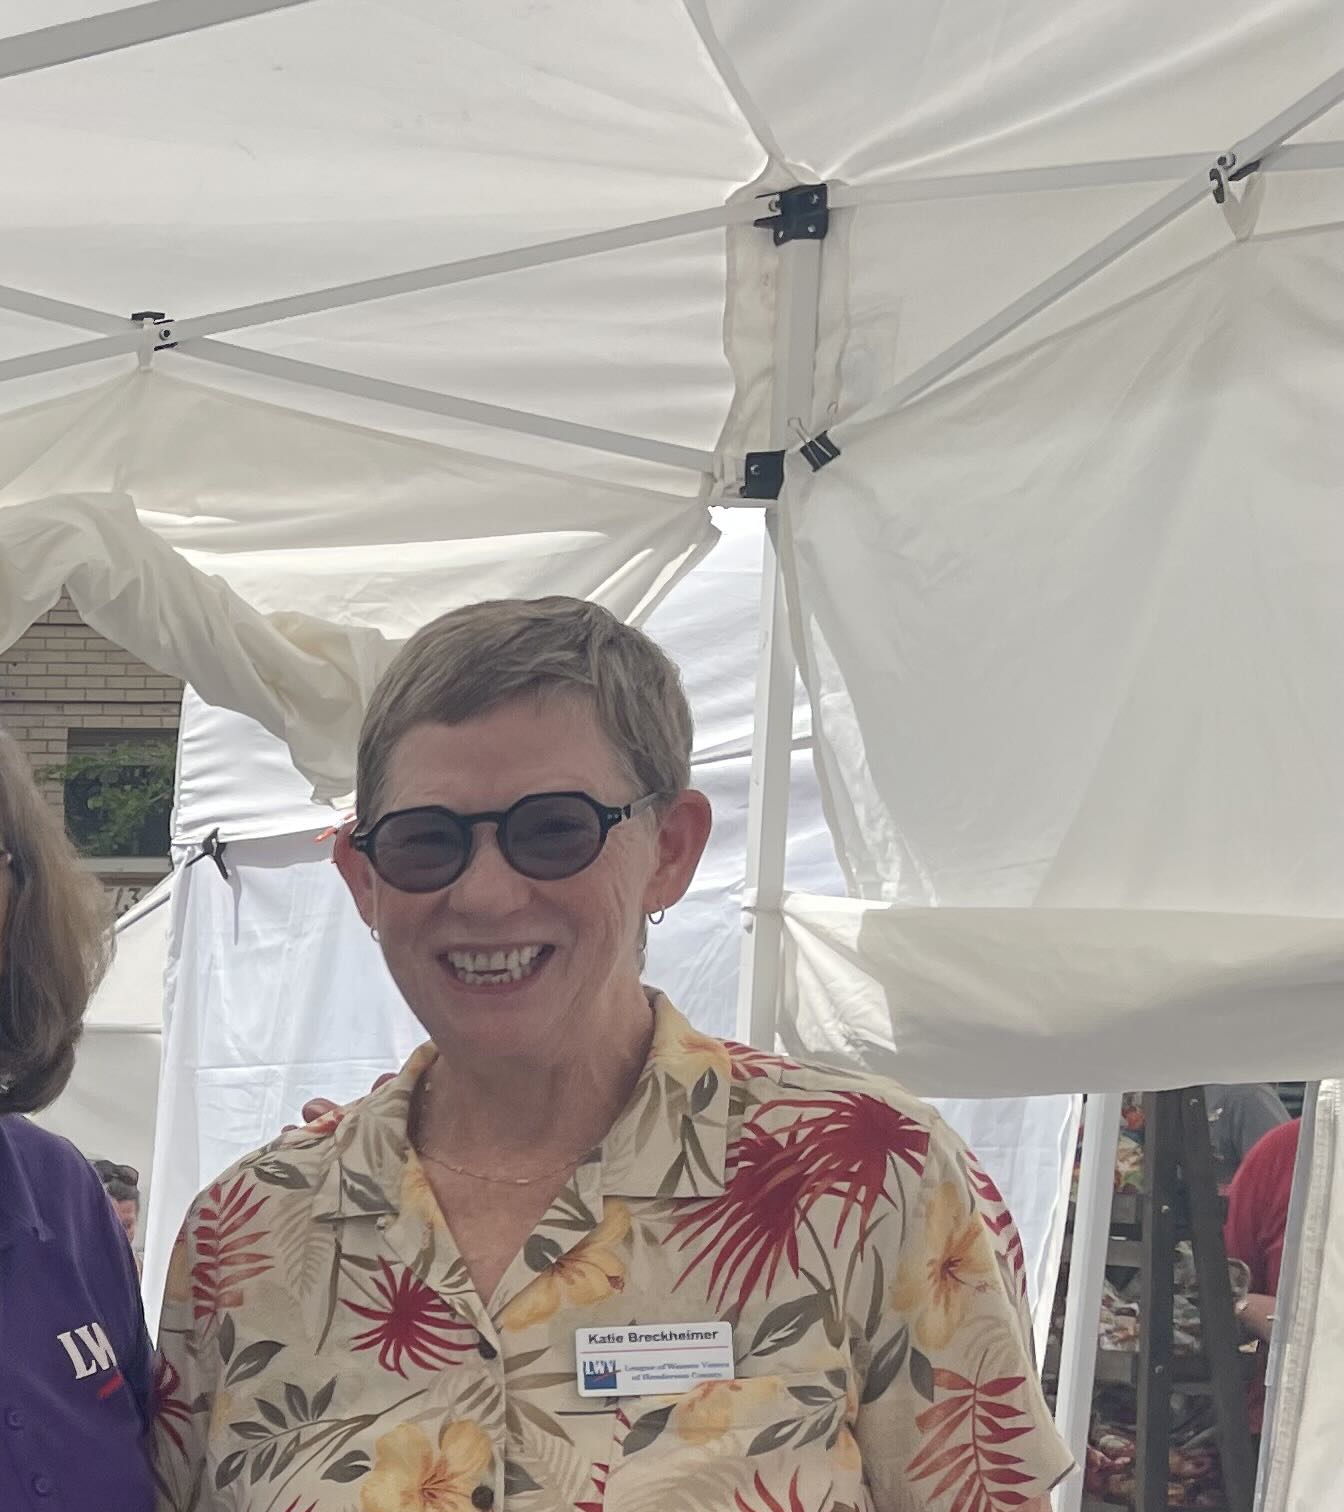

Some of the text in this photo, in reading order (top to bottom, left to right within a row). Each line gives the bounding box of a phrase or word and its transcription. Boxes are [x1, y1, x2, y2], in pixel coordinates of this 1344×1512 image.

[56, 1322, 118, 1380] LW
[588, 1329, 719, 1345] Katie Breckheimer
